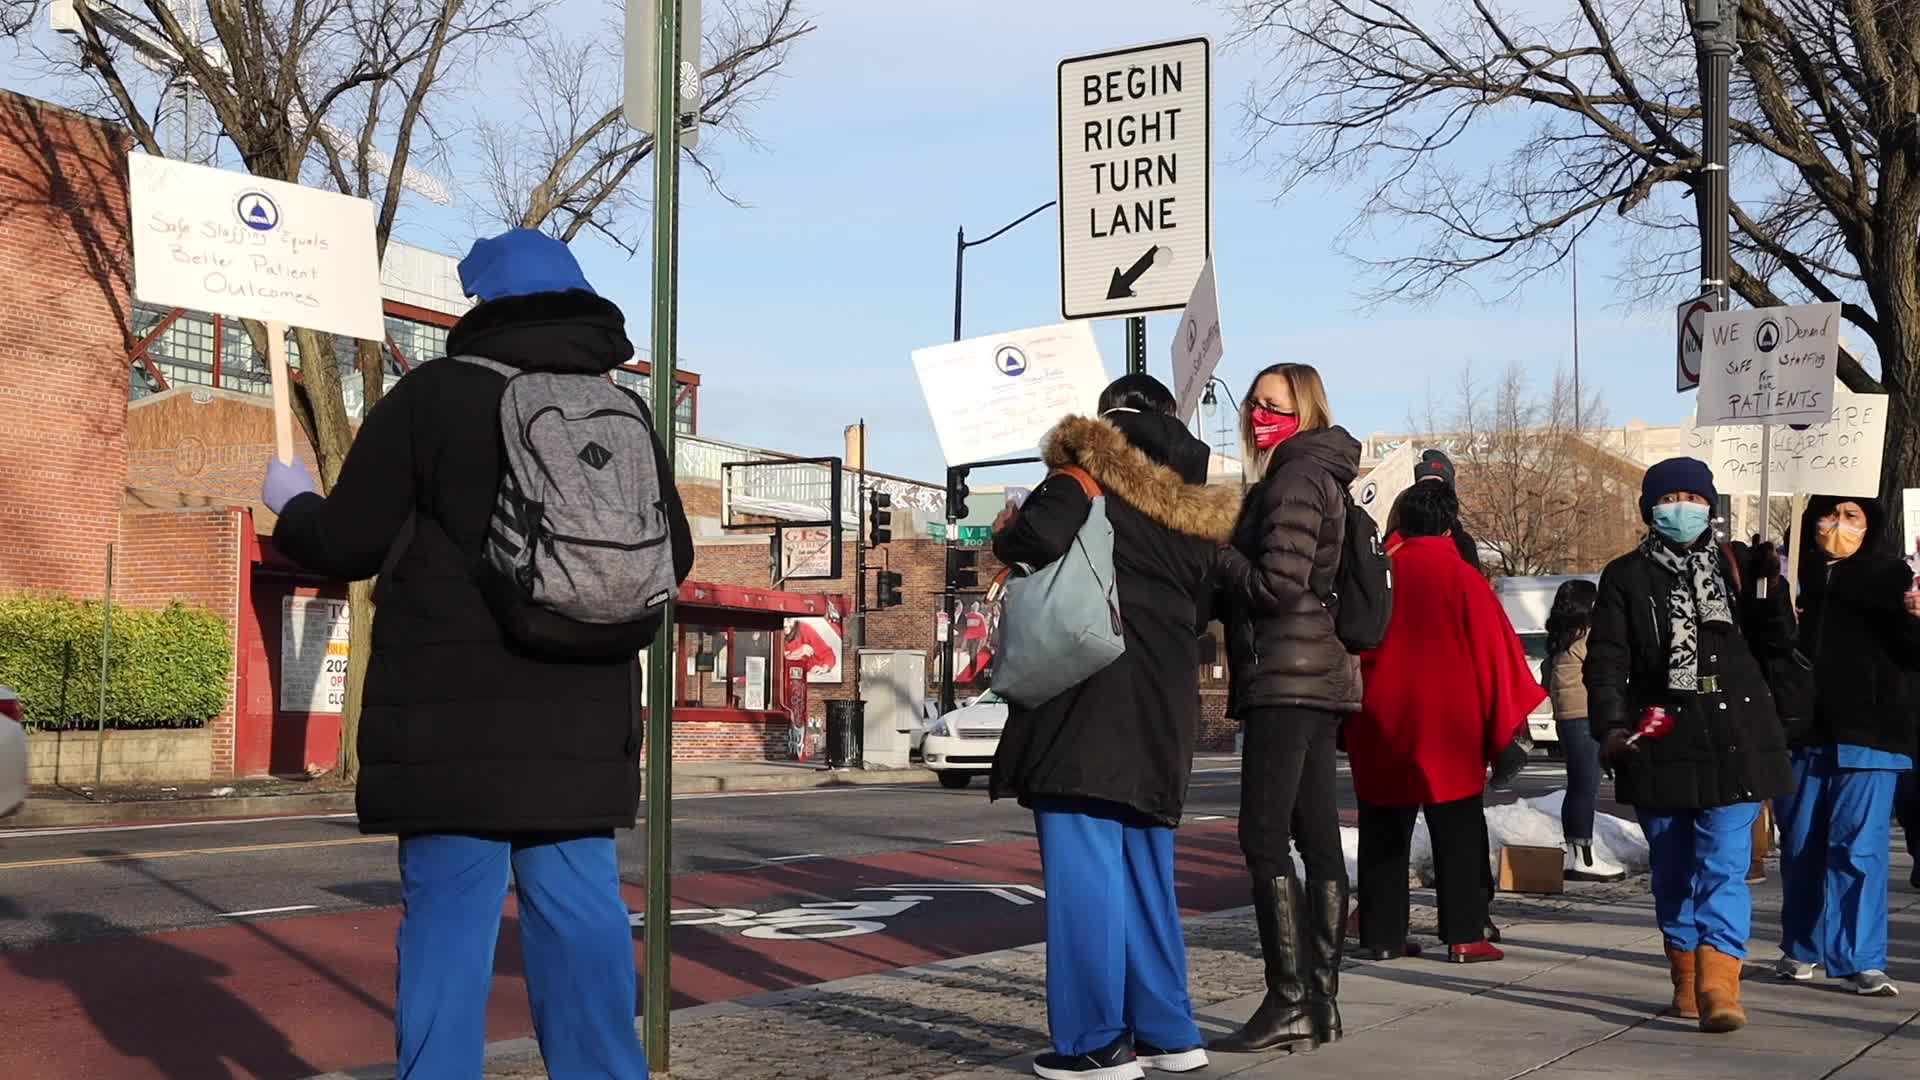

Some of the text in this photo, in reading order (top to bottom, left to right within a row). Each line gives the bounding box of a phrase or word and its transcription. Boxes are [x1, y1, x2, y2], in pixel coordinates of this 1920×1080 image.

[1083, 61, 1182, 106] BEGIN
[1084, 108, 1181, 152] RIGHT
[1090, 153, 1176, 194] TURN
[148, 212, 329, 255] Safe Staffing Equals
[1091, 197, 1176, 238] LANE
[168, 244, 319, 280] Better Patient
[204, 272, 320, 308] Outcomes
[1712, 312, 1832, 346] WE Demand
[1728, 390, 1823, 418] PATIENTS
[1831, 407, 1873, 428] ARE
[1774, 433, 1829, 450] HEART
[1810, 455, 1858, 470] CARE
